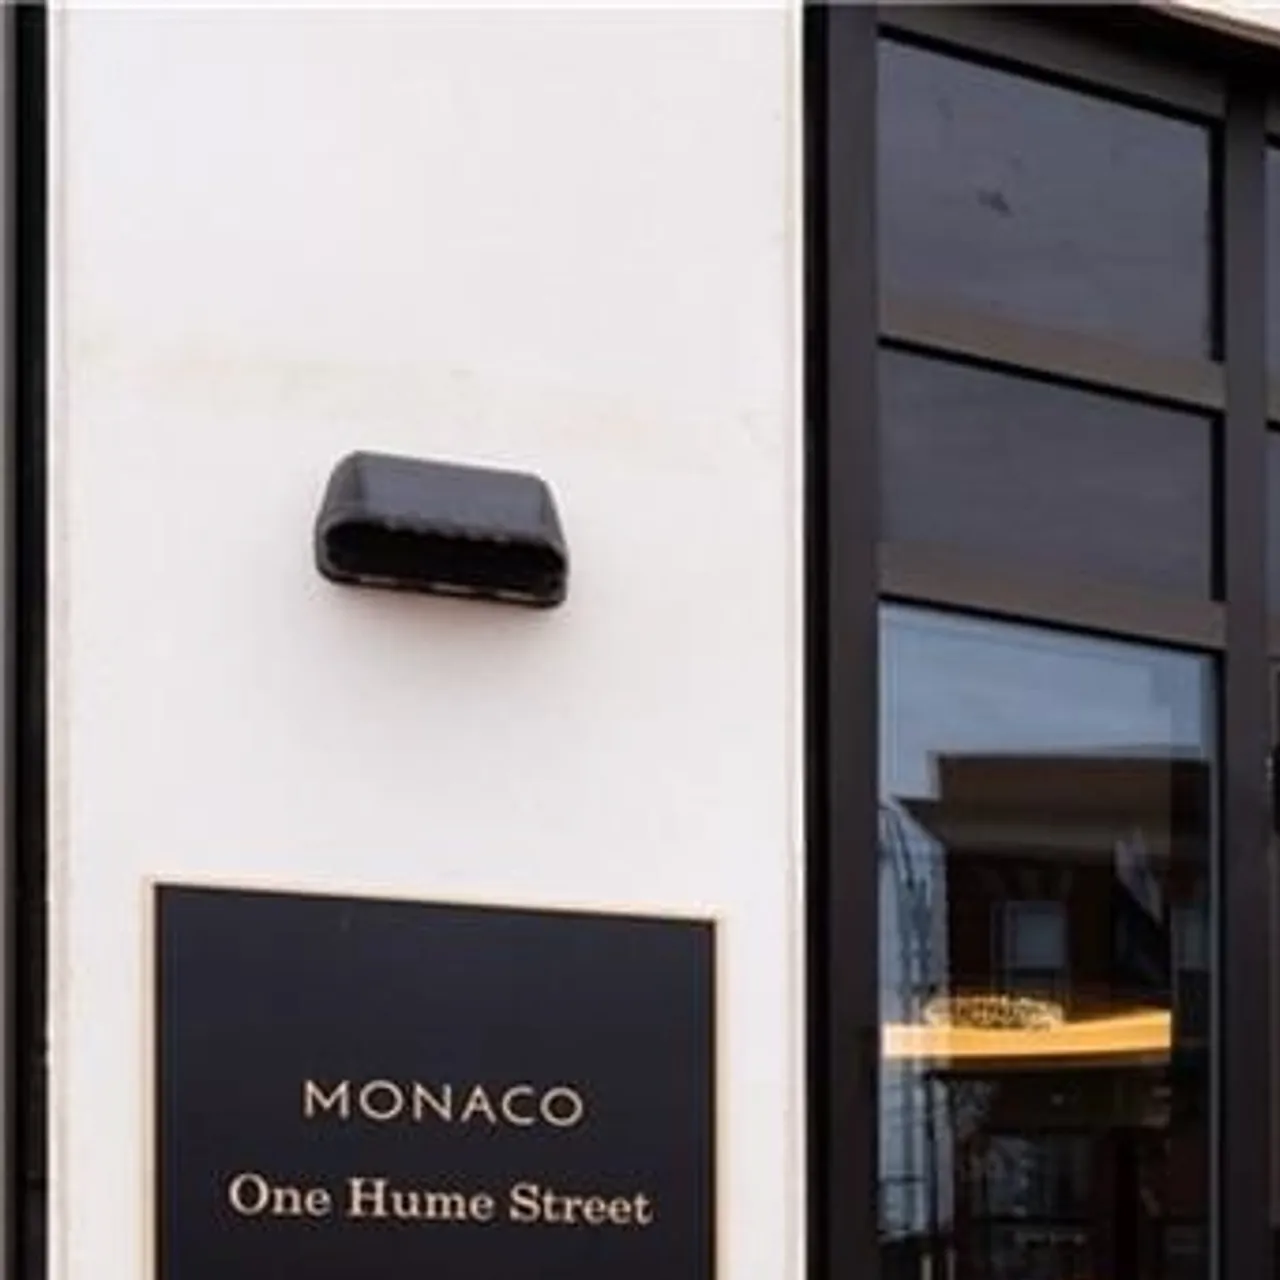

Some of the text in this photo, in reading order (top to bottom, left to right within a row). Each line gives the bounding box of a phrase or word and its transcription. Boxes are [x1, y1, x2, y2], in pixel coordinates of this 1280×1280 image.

[303, 1079, 584, 1127] MONACO
[228, 1173, 655, 1225] One Hume Street
